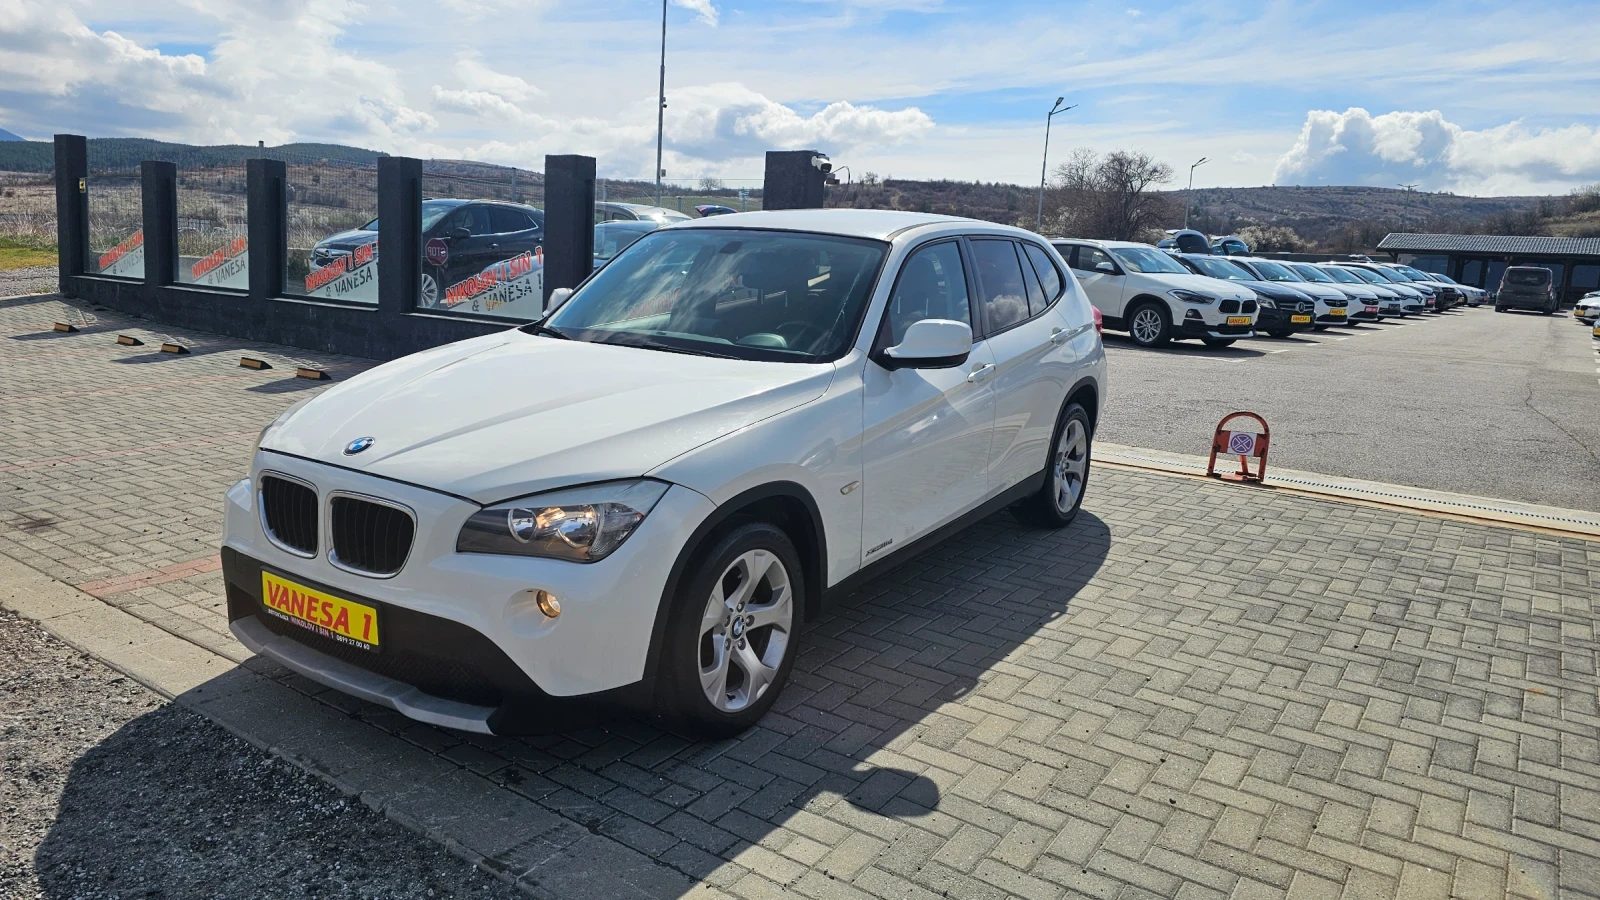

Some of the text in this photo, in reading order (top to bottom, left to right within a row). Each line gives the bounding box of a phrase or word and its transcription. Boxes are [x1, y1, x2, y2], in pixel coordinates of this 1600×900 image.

[192, 246, 224, 280] NIKOLOV
[231, 235, 246, 257] SIN
[207, 257, 246, 284] & VANESA
[305, 255, 346, 292] NIKOLOV
[354, 242, 373, 267] SIN
[445, 246, 542, 307] NIKOLOV I SIN 1
[325, 266, 373, 298] & VANESA
[471, 299, 480, 312] &
[484, 277, 532, 312] VANESA
[267, 580, 372, 640] VANESA 1
[290, 615, 315, 632] NIKOLOV
[319, 627, 329, 637] SIN
